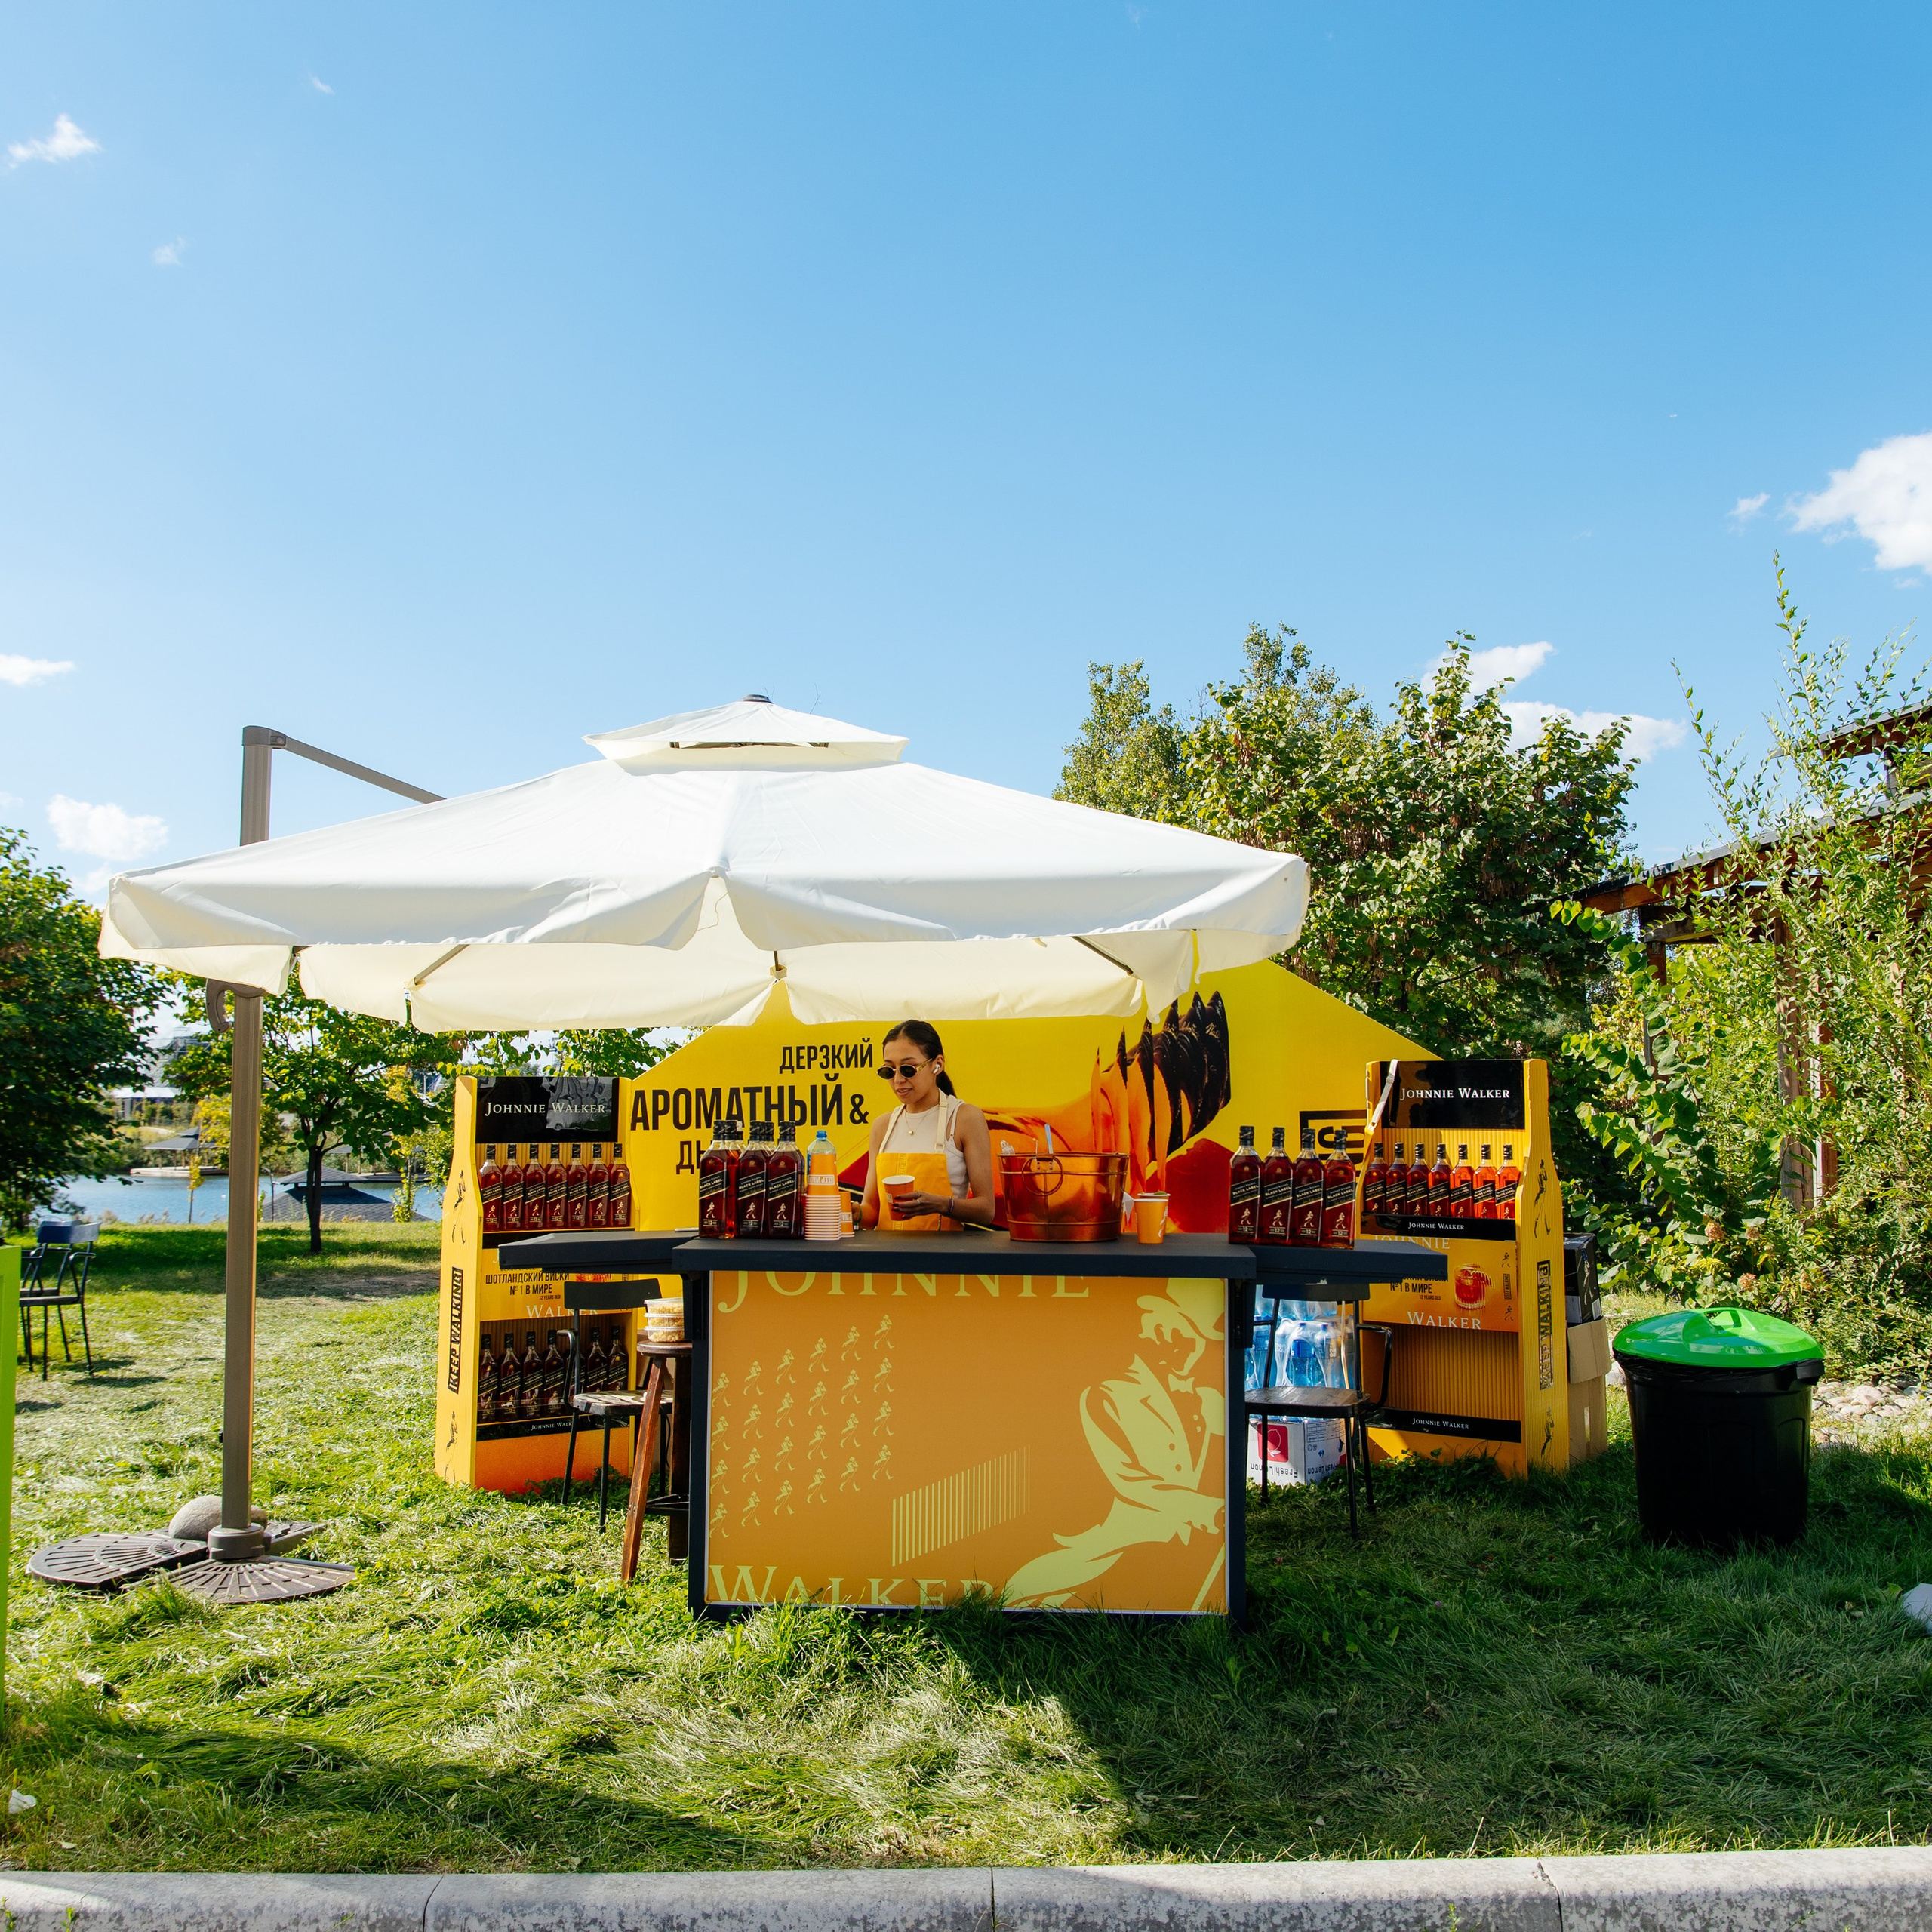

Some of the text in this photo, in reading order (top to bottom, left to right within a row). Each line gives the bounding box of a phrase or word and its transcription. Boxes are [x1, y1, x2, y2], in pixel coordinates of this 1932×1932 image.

[779, 1037, 873, 1074] ДЕРЗКИЙ
[630, 1072, 869, 1131] АРОМАТНЫЙ &
[1400, 1088, 1510, 1101] JOHNNIE WALKER
[485, 1102, 605, 1117] JOHNNIE WALKER
[485, 1270, 570, 1284] ШОТЛАНДСКИЙ ВИСКИ
[525, 1284, 531, 1295] В
[532, 1284, 552, 1294] МИРЕ
[1404, 1282, 1410, 1293] В
[1411, 1283, 1432, 1294] МИРЕ
[1407, 1311, 1481, 1330] WALKER
[1538, 1266, 1552, 1384] KEEP WALKING
[449, 1275, 463, 1391] KEEP WALKING
[531, 1423, 555, 1431] JOHNNIE
[1412, 1417, 1469, 1429] JOHNNIE WALKER
[1251, 1463, 1298, 1478] Fresh Lmon
[1307, 1466, 1324, 1475] Lemon
